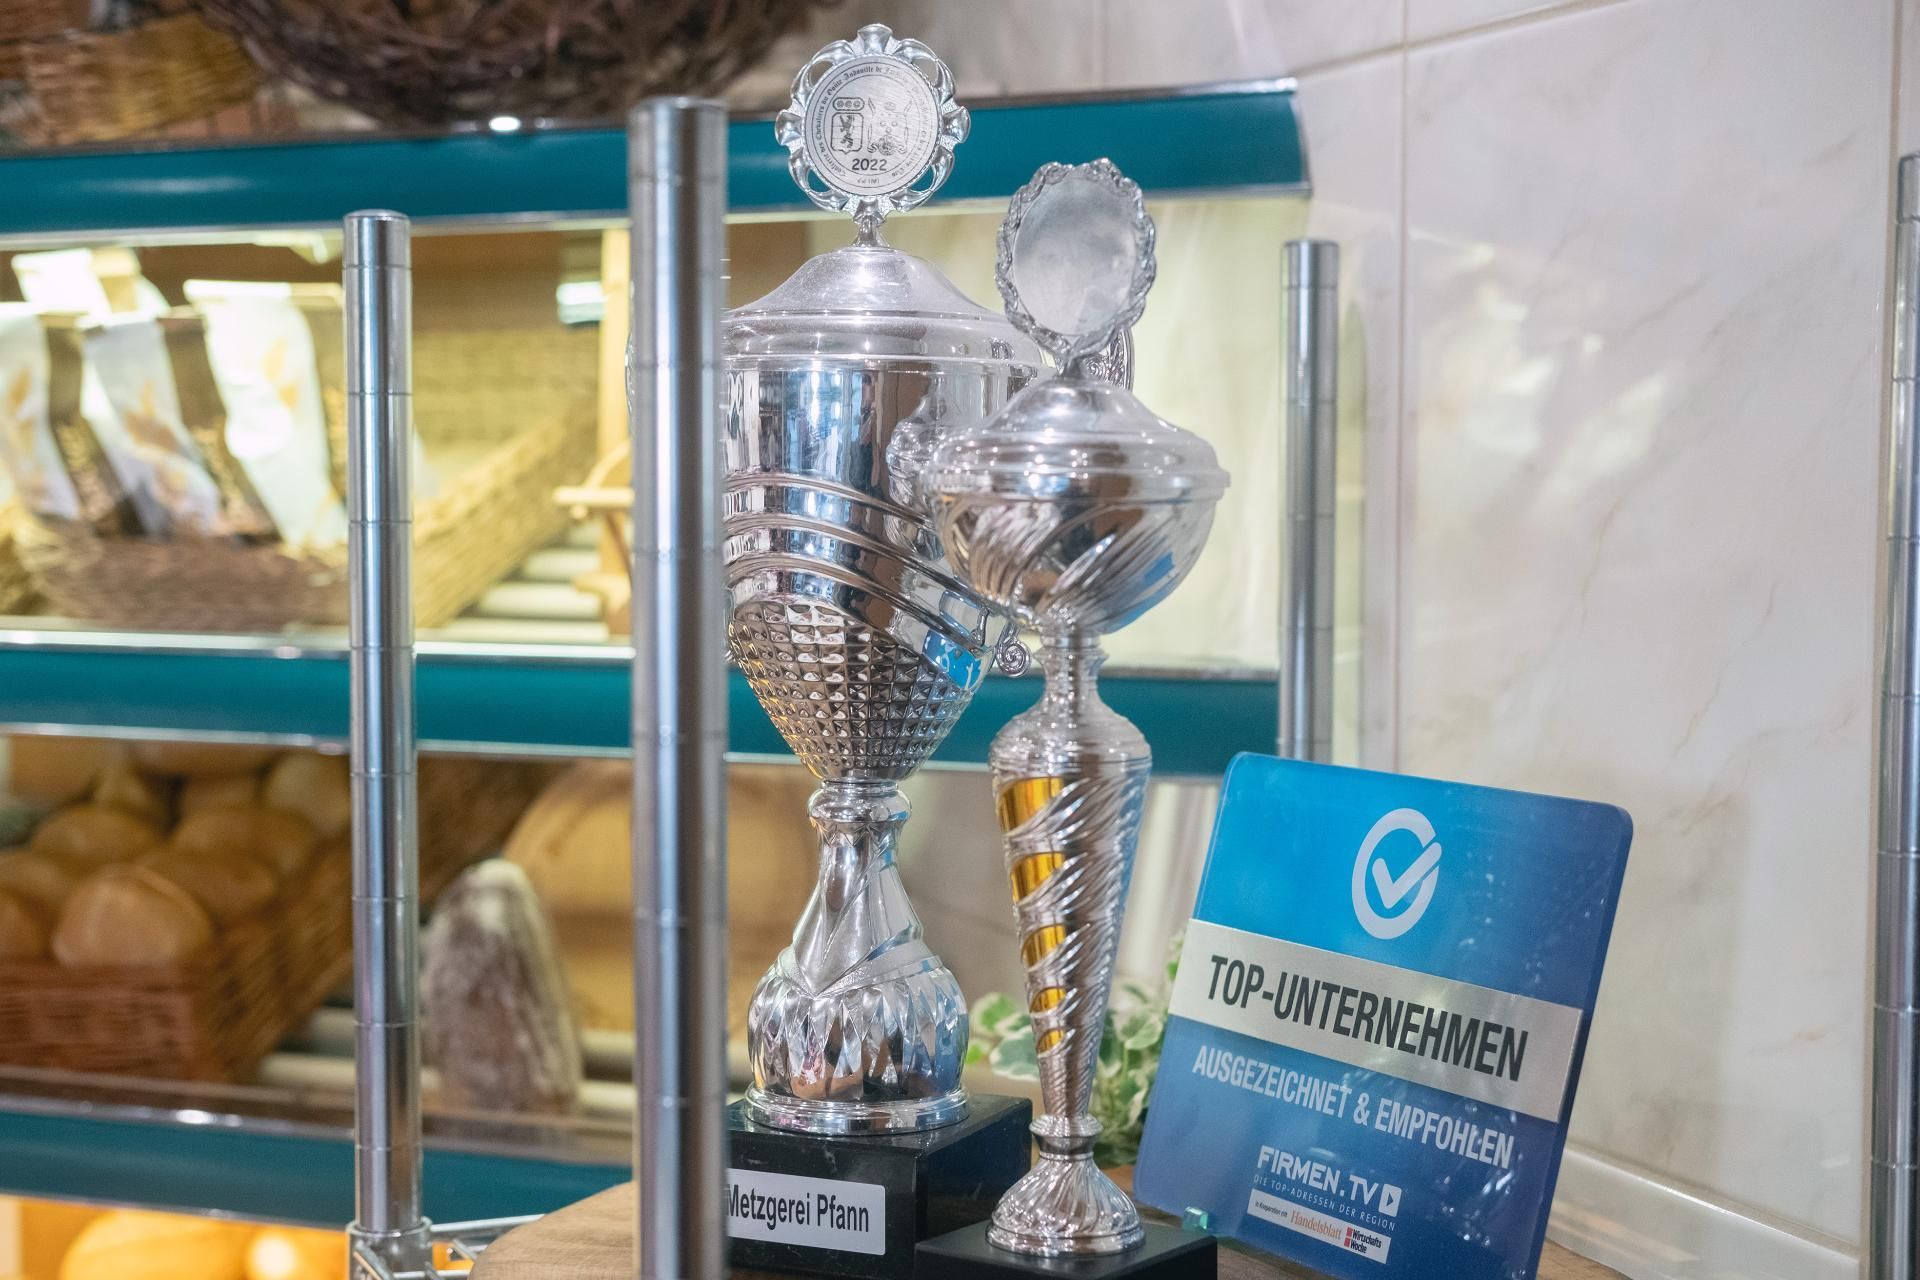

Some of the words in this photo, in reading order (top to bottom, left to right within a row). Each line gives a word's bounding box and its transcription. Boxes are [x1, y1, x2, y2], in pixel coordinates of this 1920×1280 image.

[852, 158, 887, 171] 2022
[1207, 954, 1529, 1082] TOP-UNTERNEHMEN
[1192, 1044, 1353, 1119] AUSGEZEICHNET
[1353, 1092, 1371, 1126] &
[1375, 1099, 1515, 1169] EMPFOHLEN
[1257, 1144, 1379, 1205] FIRMEN.TV
[727, 1184, 810, 1230] Metzgerei
[817, 1193, 869, 1232] Pfann
[1253, 1174, 1268, 1186] DIE
[1270, 1180, 1335, 1210] TOP-ADRESSEN
[1339, 1203, 1356, 1217] DER
[1360, 1212, 1396, 1232] REGION
[1290, 1209, 1342, 1240] Handelsblatt
[1350, 1239, 1368, 1254] Woche
[1352, 1228, 1382, 1248] Wirtschafts
